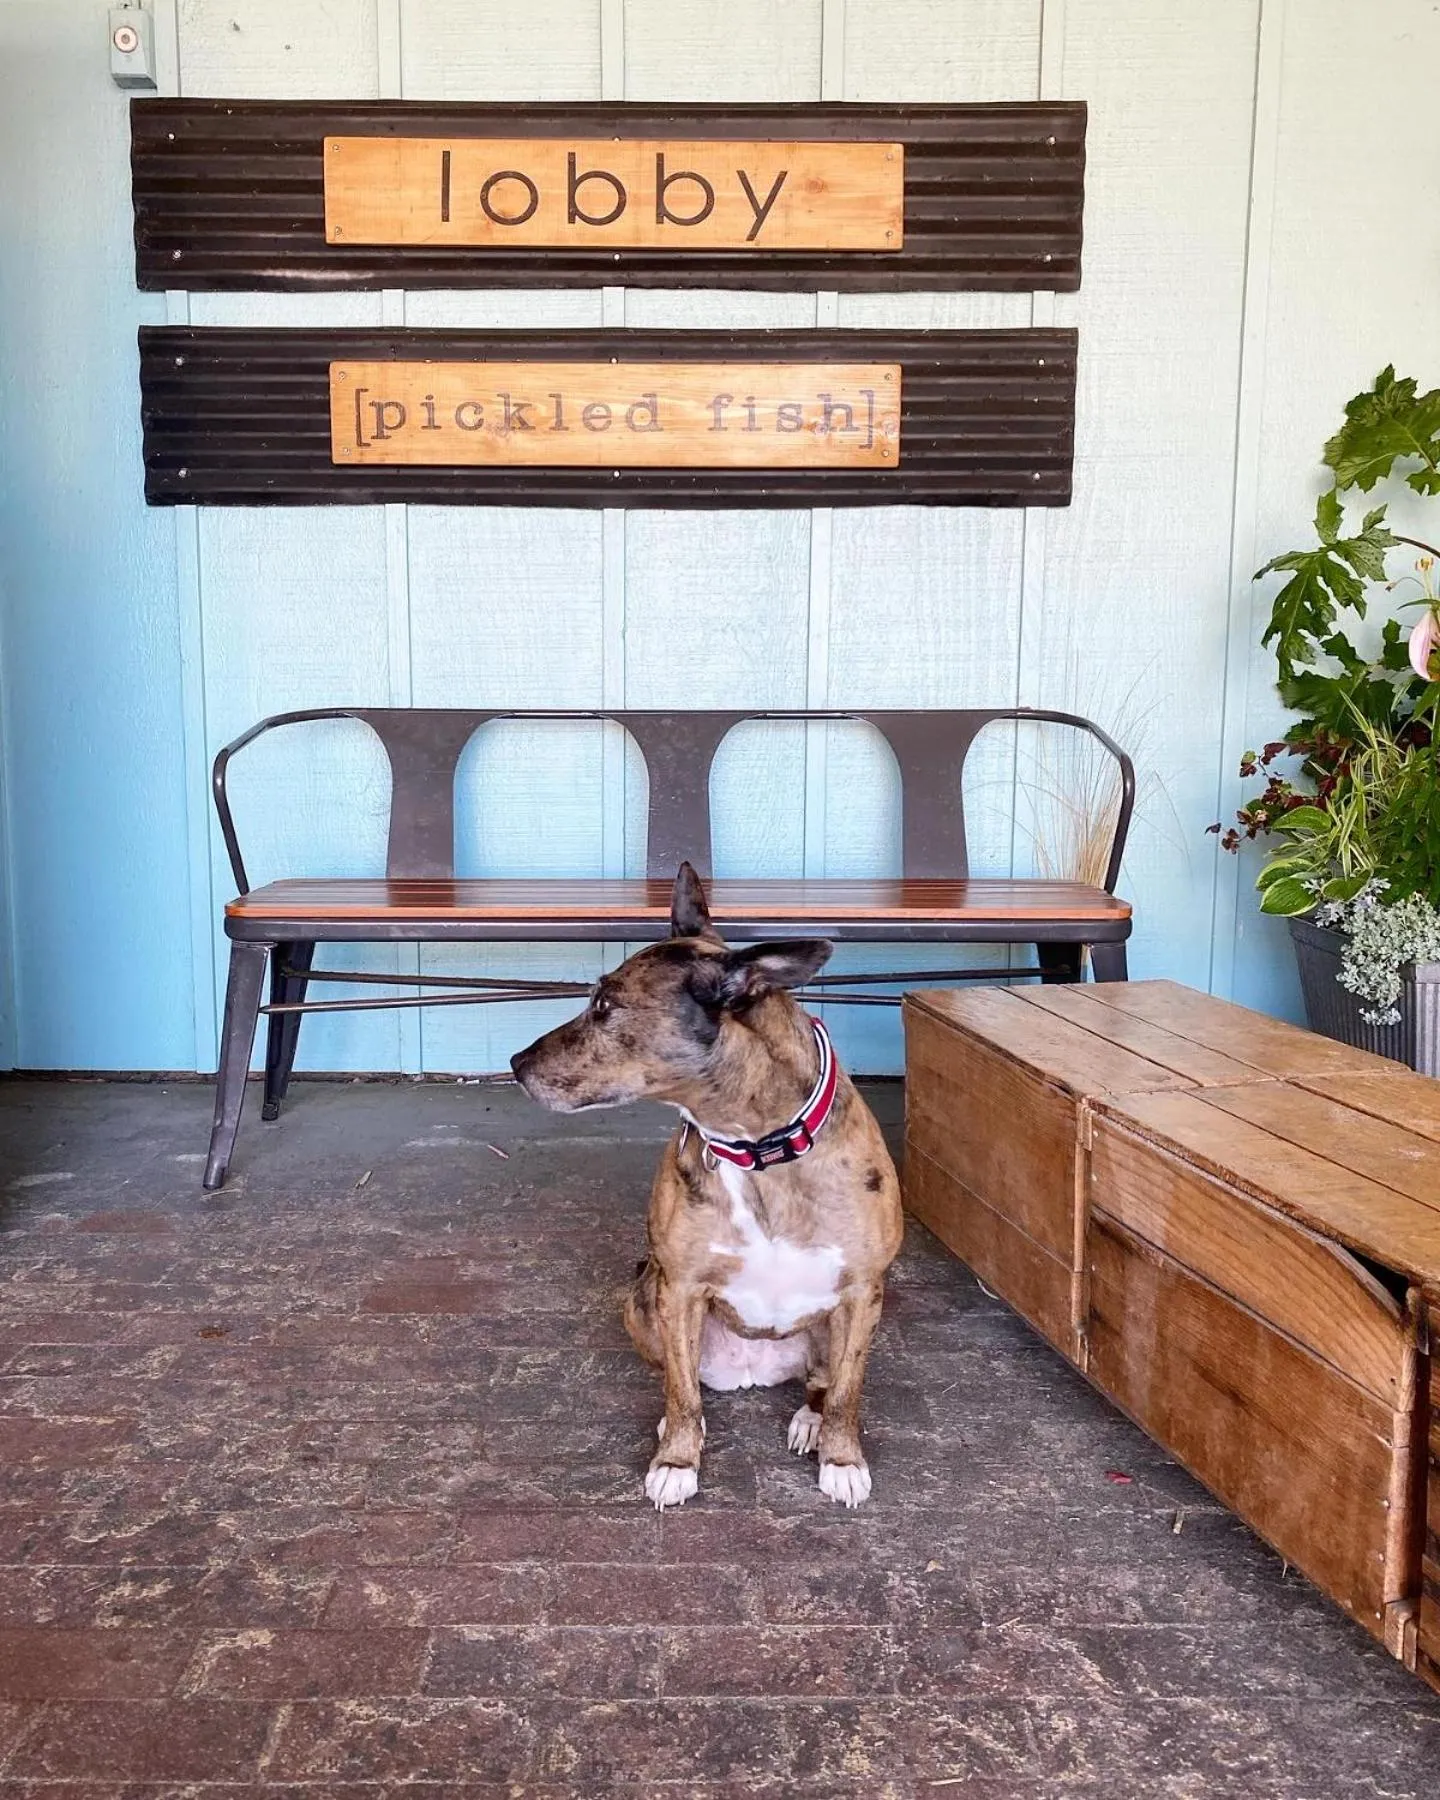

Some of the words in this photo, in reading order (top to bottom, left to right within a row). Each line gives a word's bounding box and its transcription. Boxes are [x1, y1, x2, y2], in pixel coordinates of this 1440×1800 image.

[441, 150, 788, 241] lobby
[355, 388, 664, 447] [pickled
[707, 390, 875, 449] fish]
